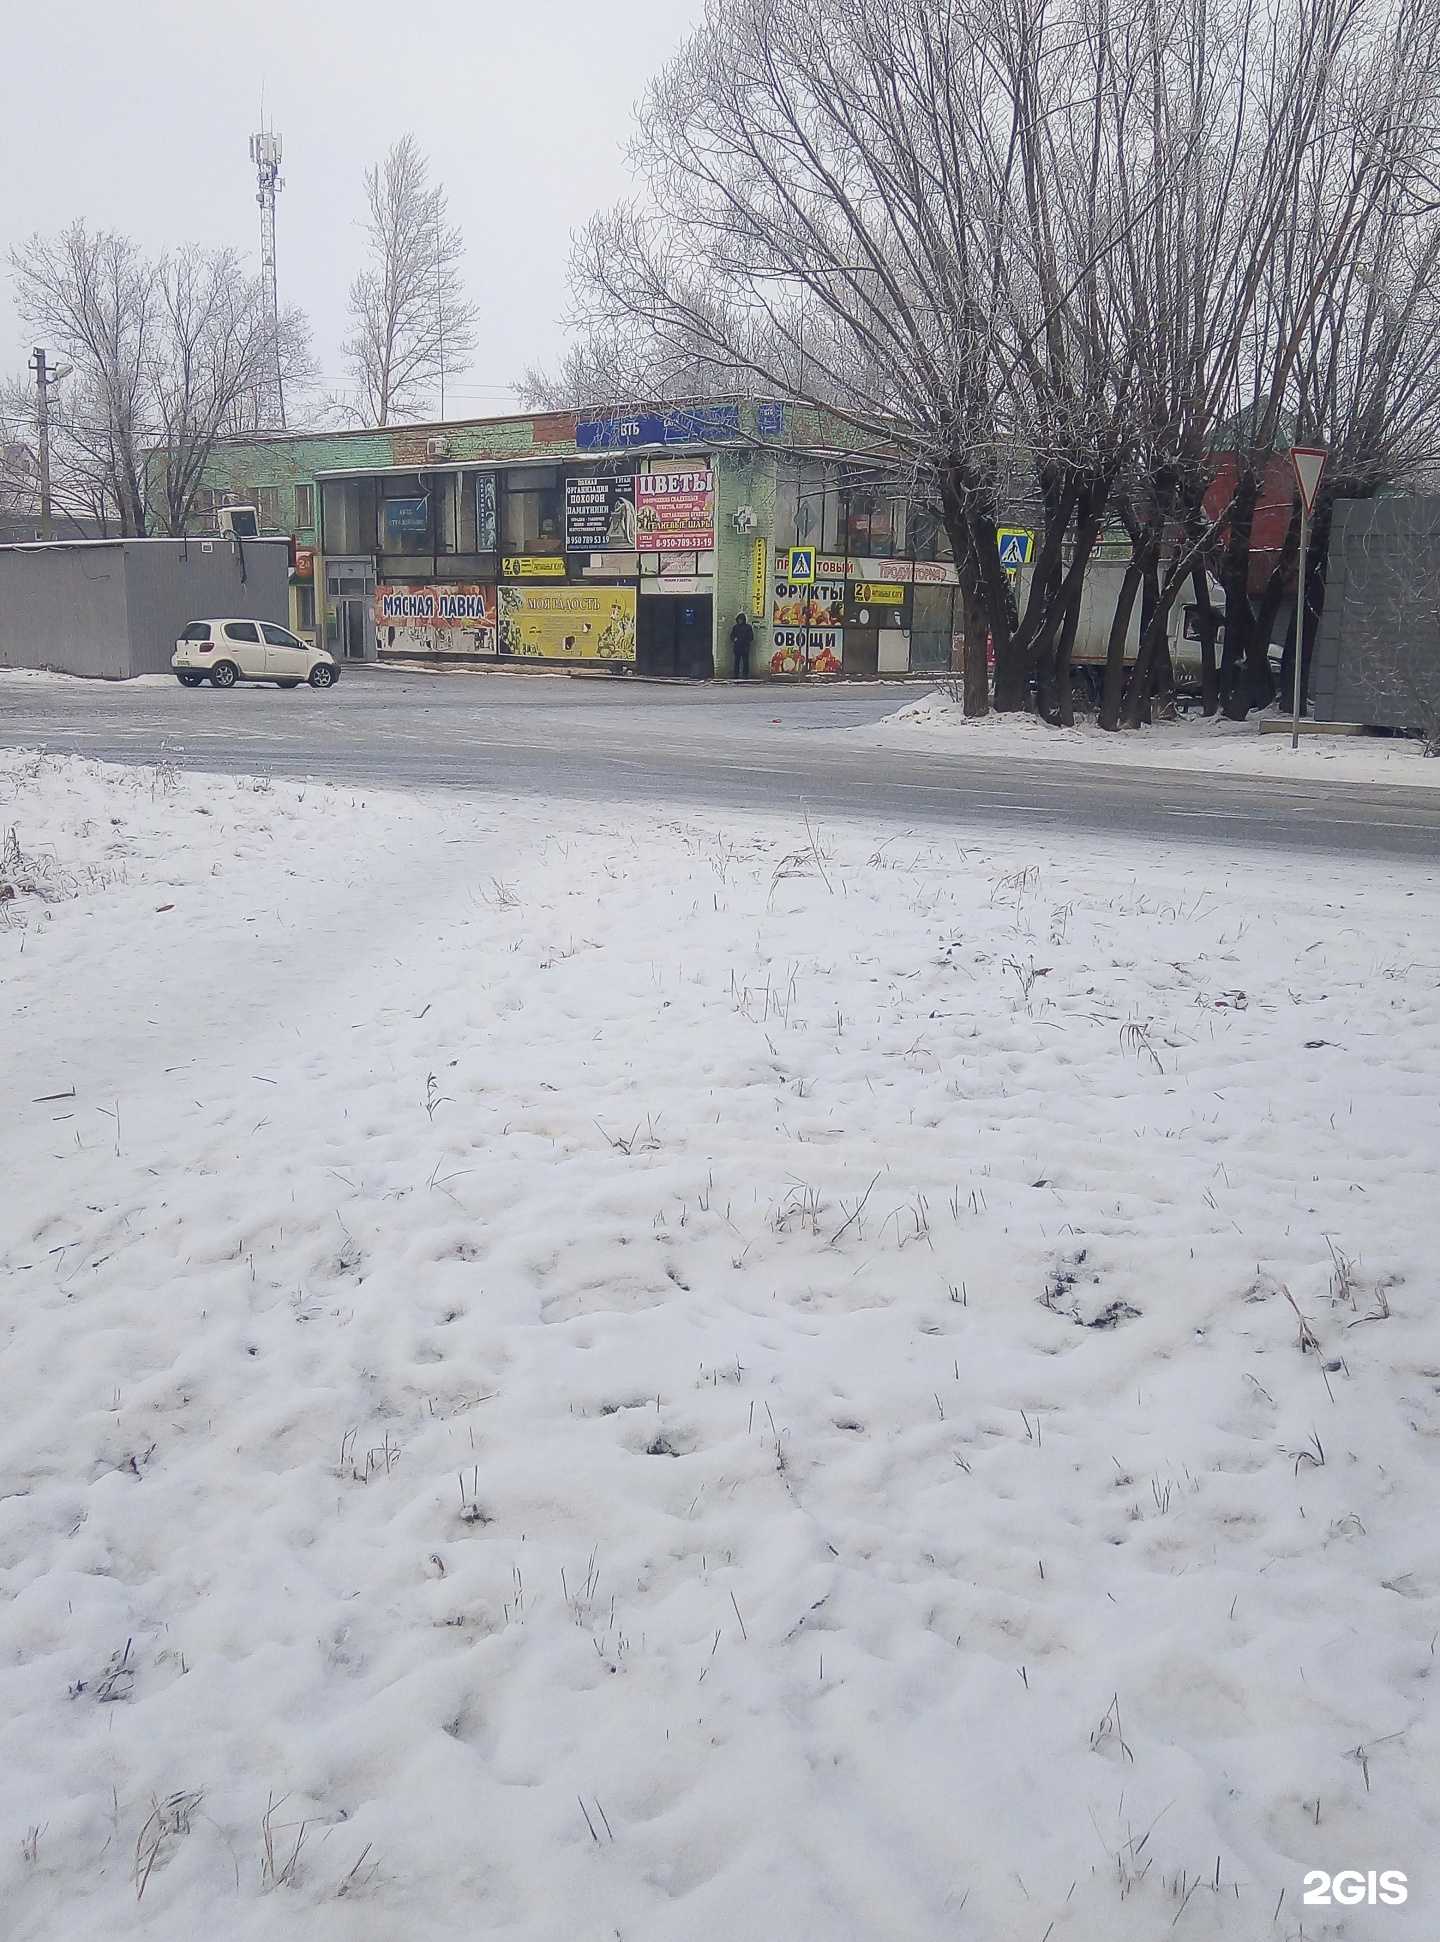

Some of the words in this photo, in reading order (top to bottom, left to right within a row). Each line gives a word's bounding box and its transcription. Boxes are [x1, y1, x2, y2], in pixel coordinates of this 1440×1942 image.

[620, 422, 640, 437] ВТБ
[640, 472, 713, 496] ЦВЕТЫ
[570, 494, 605, 504] ПОХОРОН
[567, 505, 609, 514] ПАМЯТНИКИ
[688, 519, 713, 529] ШАРЫ
[571, 536, 582, 544] 950
[583, 535, 593, 544] 789
[594, 535, 601, 543] 53
[656, 537, 712, 548] 8-950-789-53-19
[776, 558, 854, 574] ПРТОВЫЙ
[775, 583, 844, 601] ФРУКТЫ
[383, 595, 434, 618] МЯСНАЯ
[438, 595, 486, 618] ЛАВКА
[527, 597, 551, 610] МОЯ
[774, 632, 836, 649] ОВОЩИ
